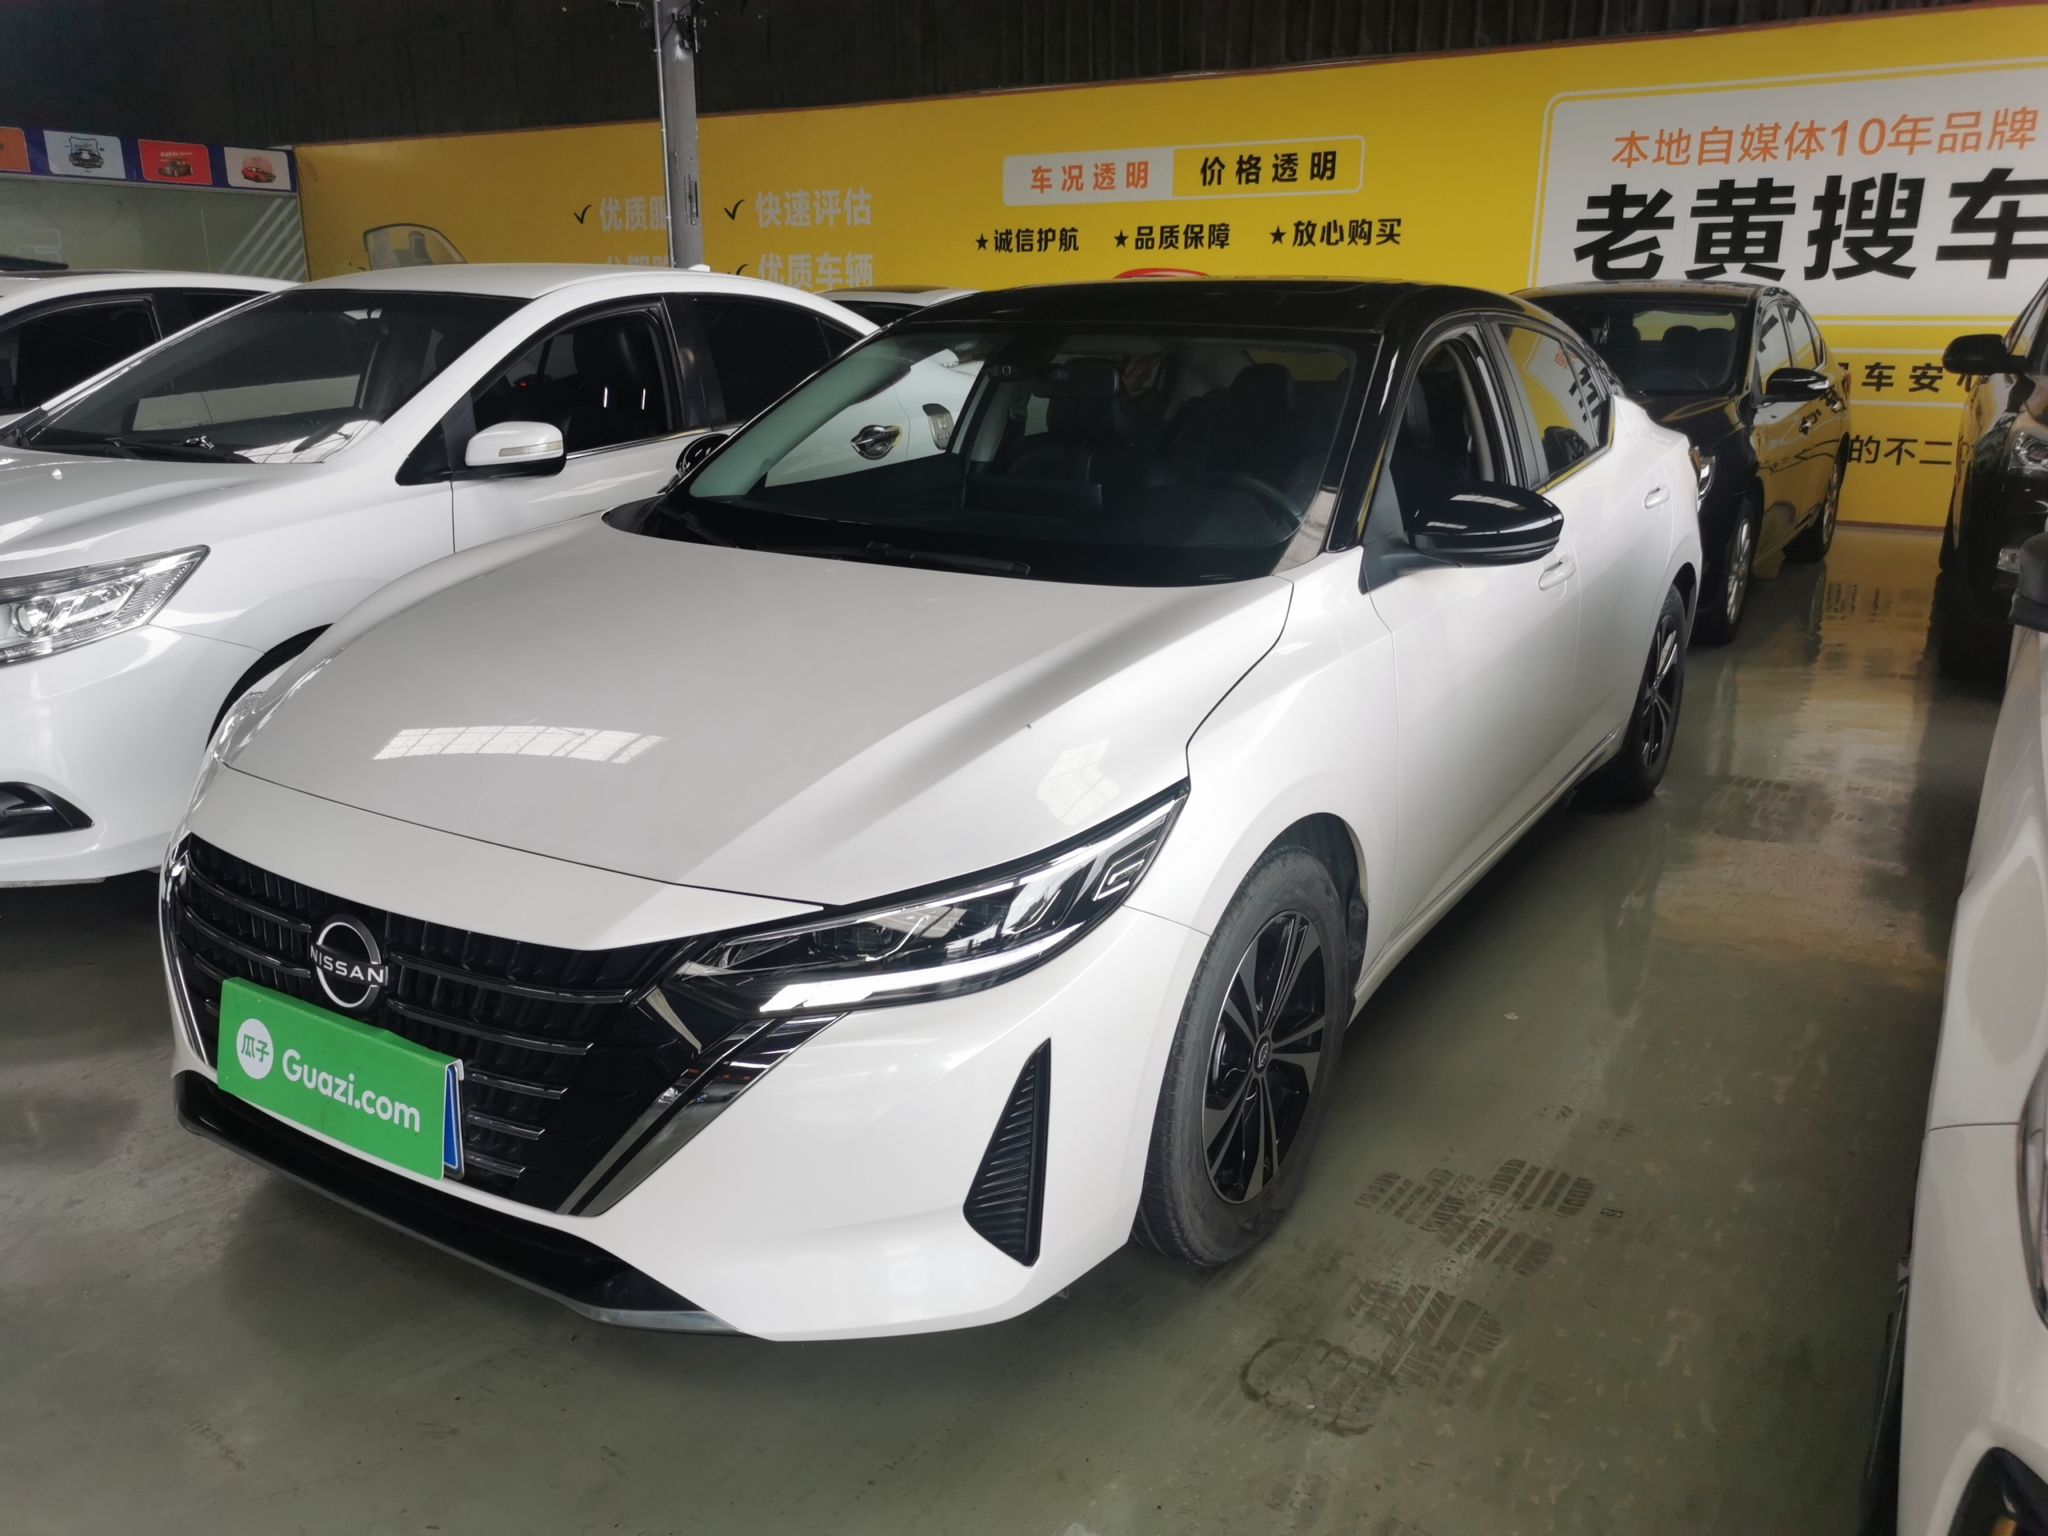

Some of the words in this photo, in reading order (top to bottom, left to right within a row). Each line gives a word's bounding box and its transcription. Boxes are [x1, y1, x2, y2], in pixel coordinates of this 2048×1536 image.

[1611, 106, 2039, 169] 本地自媒体10年品牌
[1030, 160, 1150, 194] 车况透明
[1200, 150, 1338, 187] 价格透明
[755, 187, 872, 229] 快速评估
[1573, 168, 2048, 282] 老黄搜车
[993, 226, 1080, 253] 诚信护航
[1134, 222, 1232, 251] 品质保障
[1292, 217, 1402, 247] 放心购买
[758, 252, 873, 290] 优质车辆
[310, 944, 387, 985] NISSAN
[241, 1033, 270, 1063] 瓜子
[282, 1048, 421, 1133] Guazi.com
